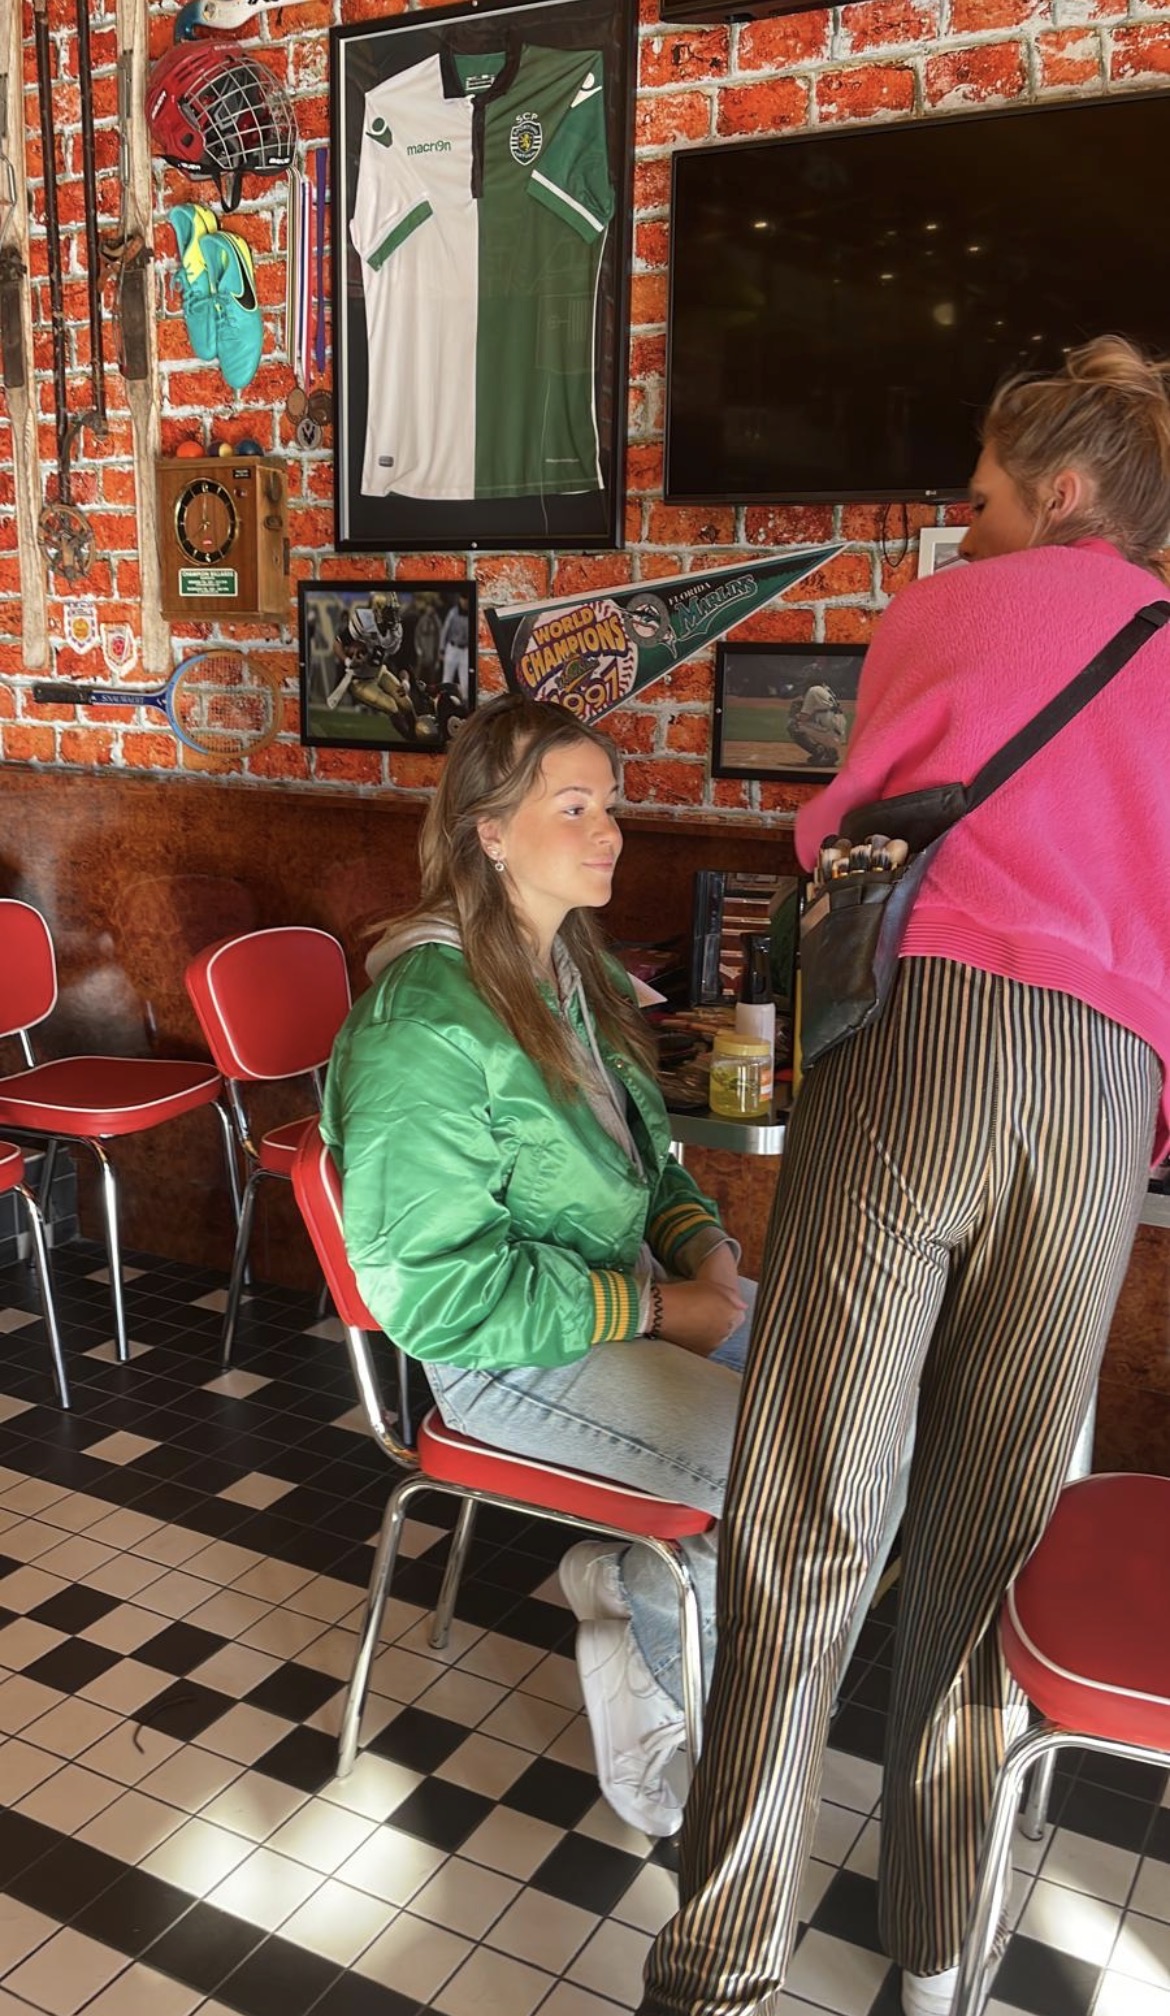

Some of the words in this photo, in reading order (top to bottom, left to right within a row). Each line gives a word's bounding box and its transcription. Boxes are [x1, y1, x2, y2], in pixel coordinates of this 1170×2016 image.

[515, 111, 538, 124] SCP
[668, 582, 712, 605] FLORIDA
[533, 605, 595, 645] WORLD
[519, 615, 627, 689] CHAMPIONS
